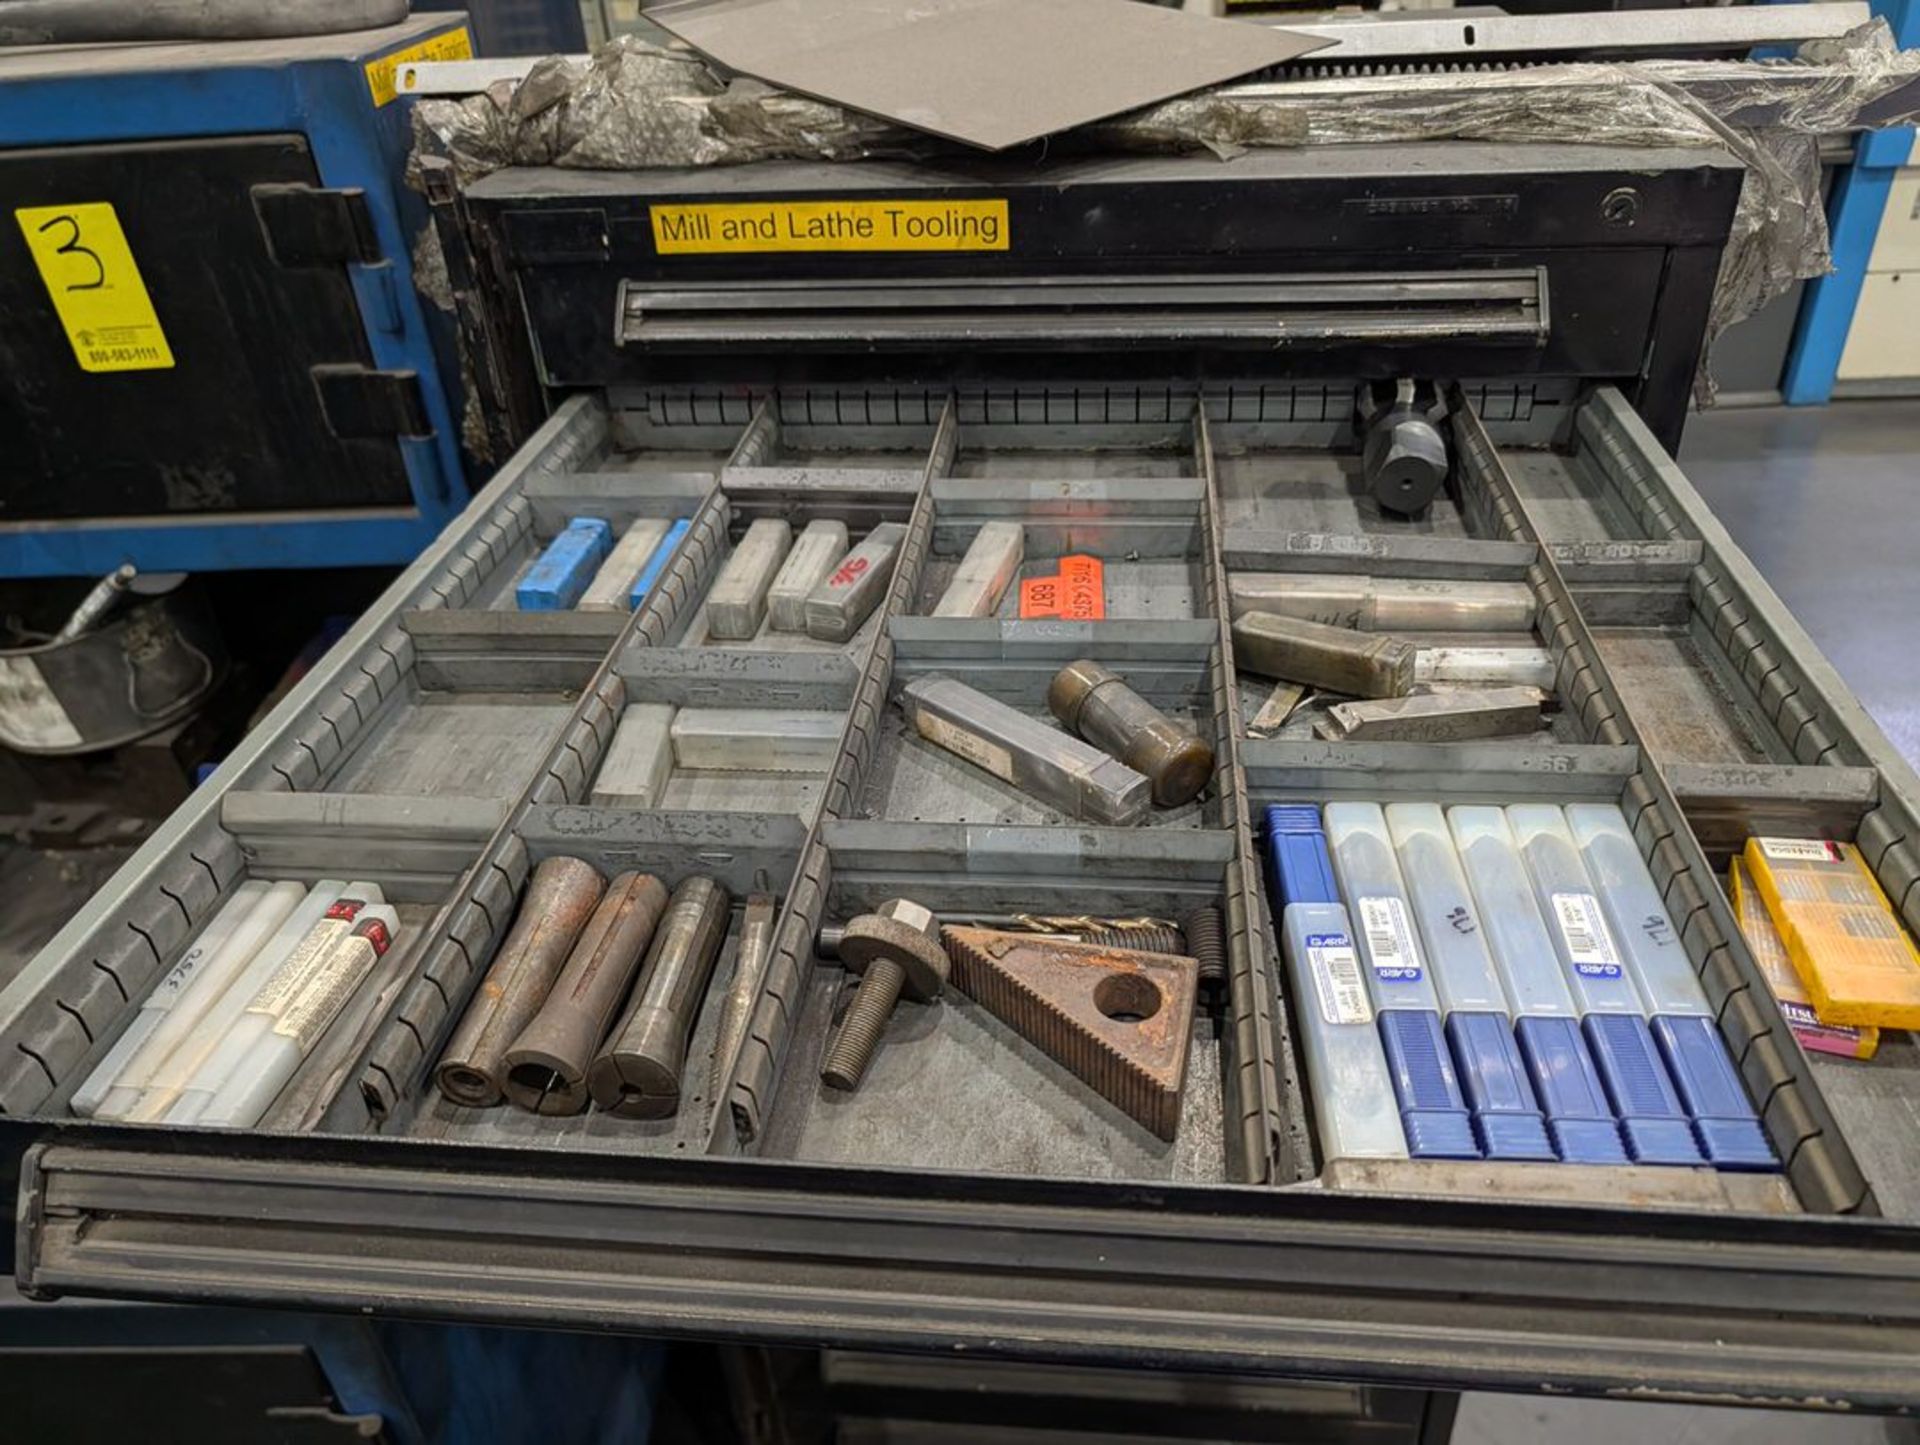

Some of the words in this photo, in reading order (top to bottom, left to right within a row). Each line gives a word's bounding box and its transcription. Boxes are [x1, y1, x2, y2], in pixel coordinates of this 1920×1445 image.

[660, 213, 711, 240] Mill
[722, 213, 777, 239] and
[788, 211, 873, 239] Lathe
[884, 209, 999, 244] Tooling
[38, 215, 104, 291] 3
[1030, 584, 1055, 608] 687
[1379, 967, 1419, 979] GARR
[1578, 963, 1618, 975] GARR
